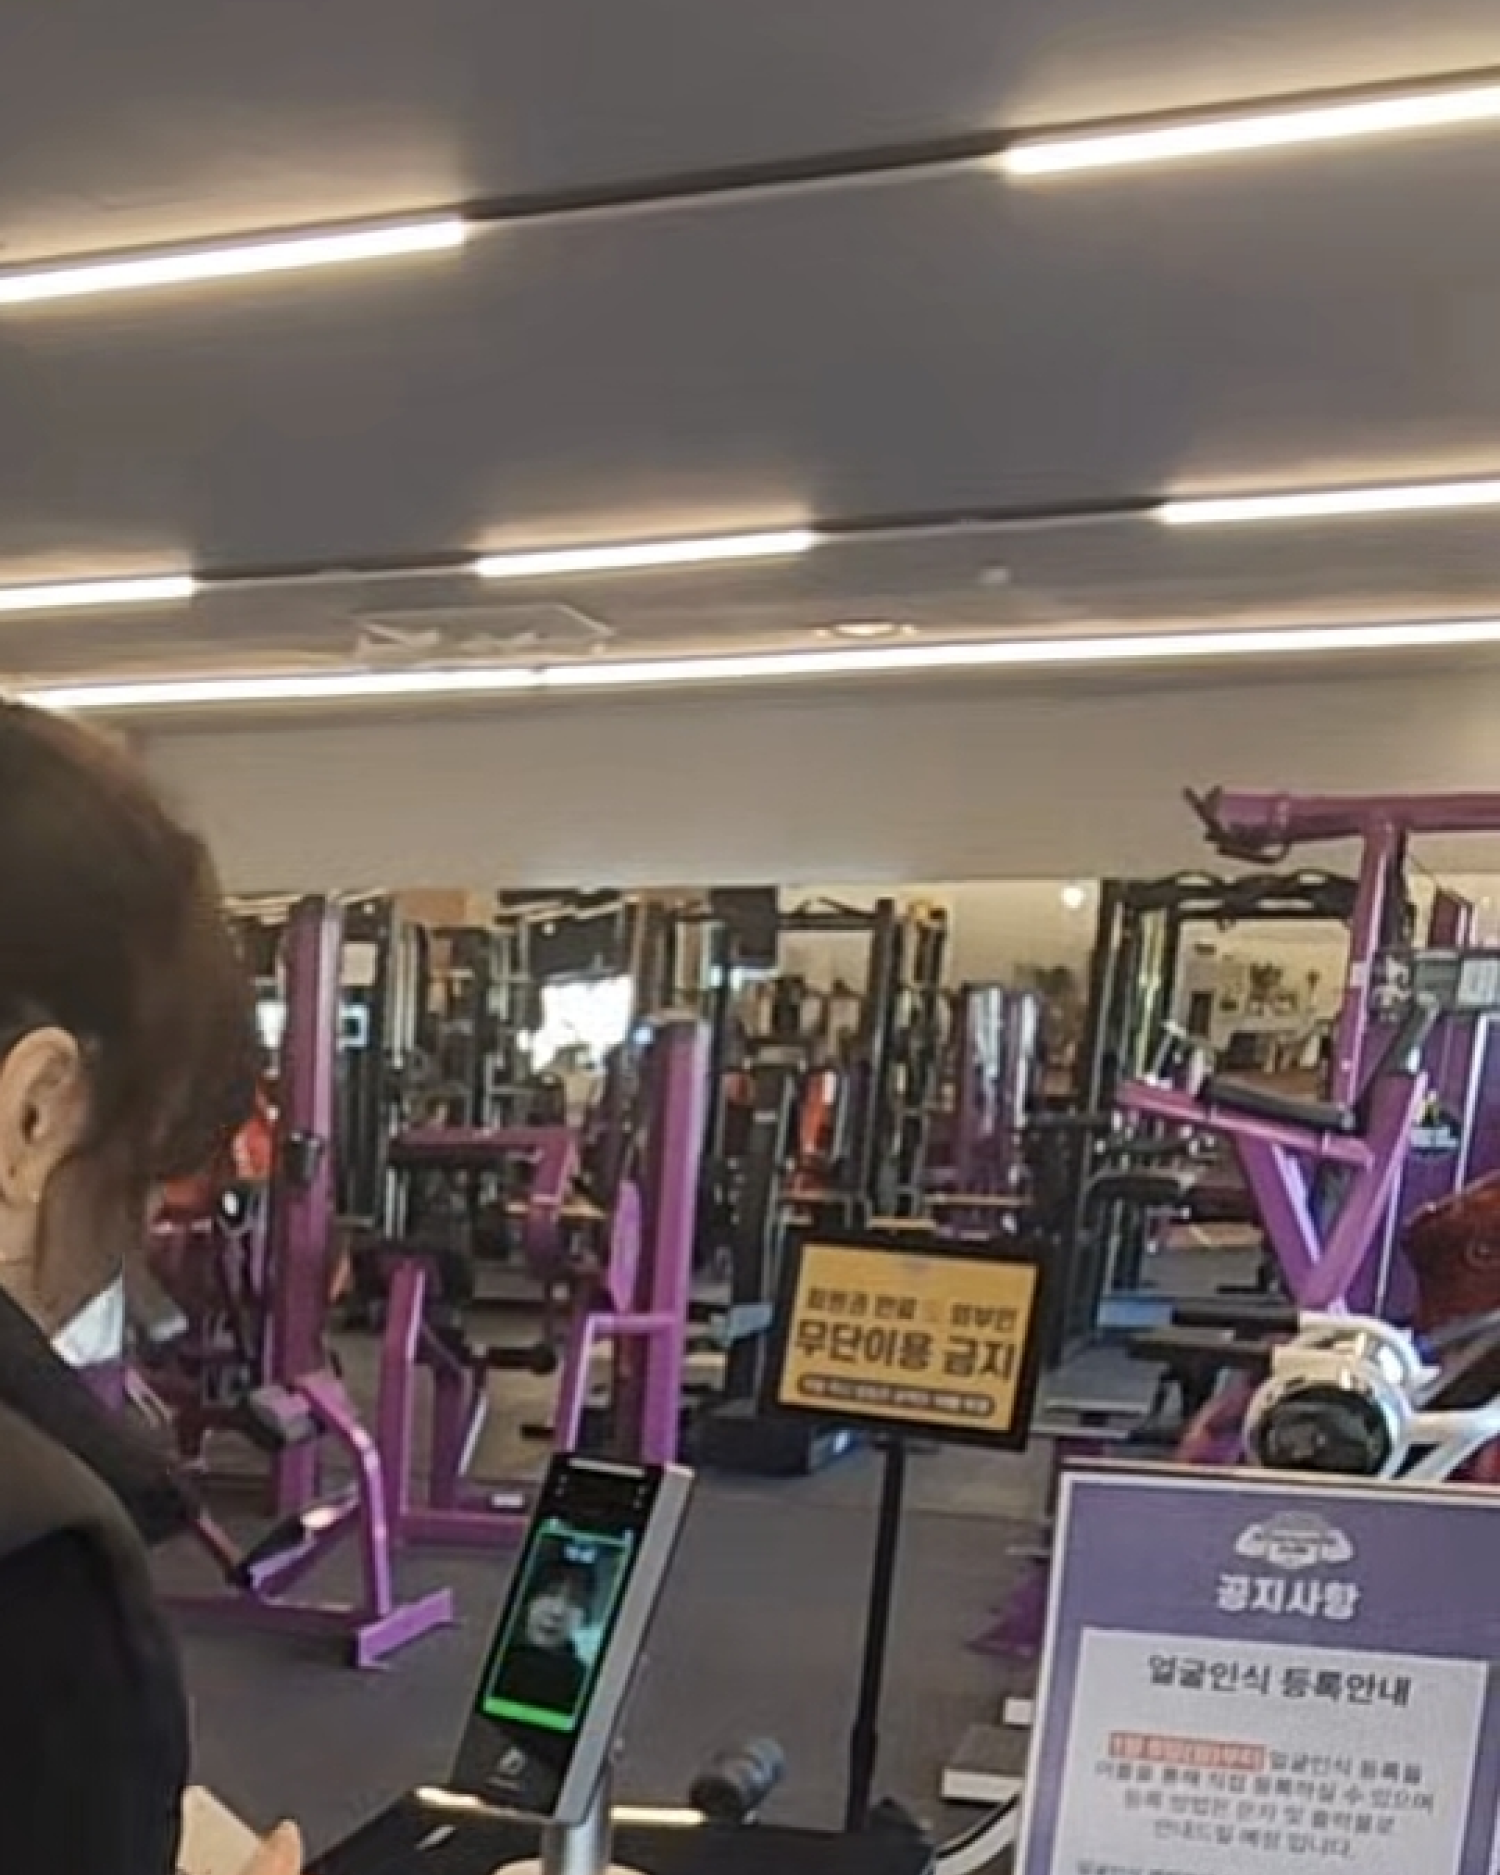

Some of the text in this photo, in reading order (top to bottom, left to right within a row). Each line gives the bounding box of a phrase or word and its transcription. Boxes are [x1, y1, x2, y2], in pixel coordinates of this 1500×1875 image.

[796, 1320, 1016, 1383] 무단이용 금지
[1217, 1573, 1363, 1620] 공지사항
[1149, 1654, 1412, 1707] 얼굴인식 등록안내
